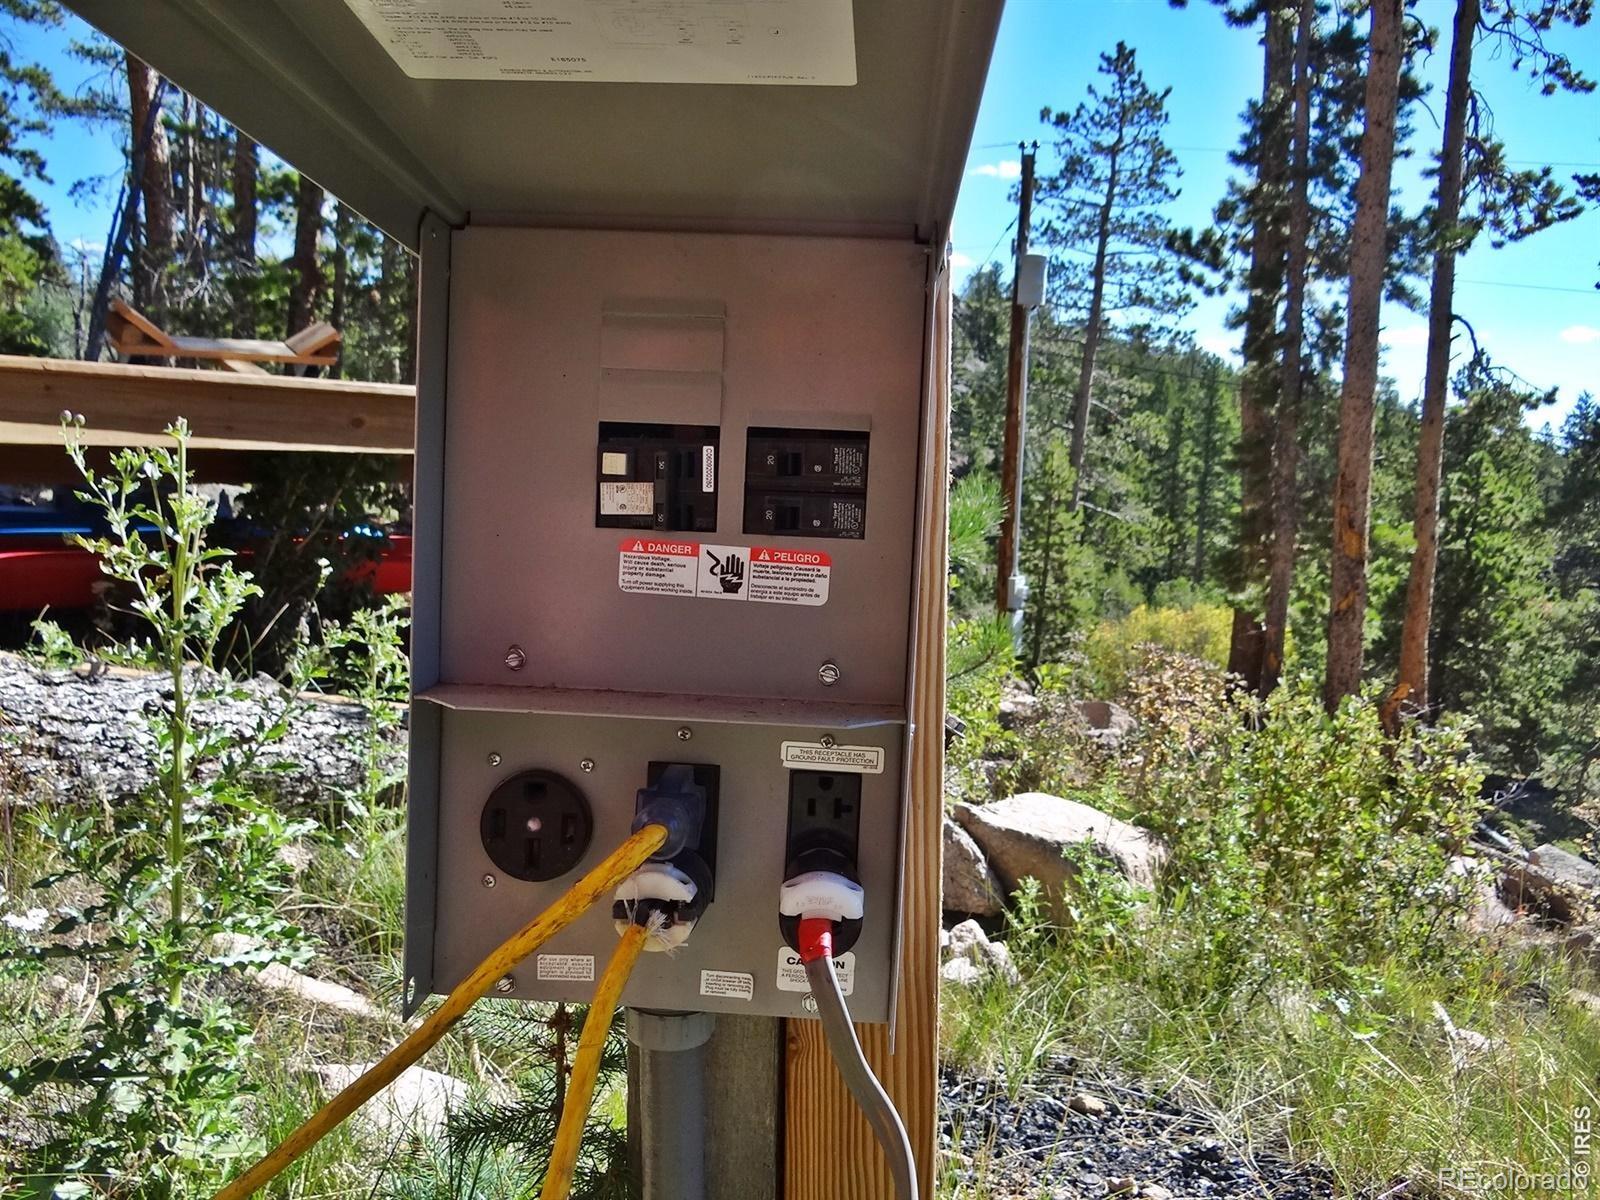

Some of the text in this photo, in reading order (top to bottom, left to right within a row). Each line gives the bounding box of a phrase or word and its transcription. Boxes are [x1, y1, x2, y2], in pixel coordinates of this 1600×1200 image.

[766, 455, 775, 465] 20
[765, 510, 773, 520] 20
[648, 542, 692, 554] DANGER
[773, 552, 820, 564] PELIGRO
